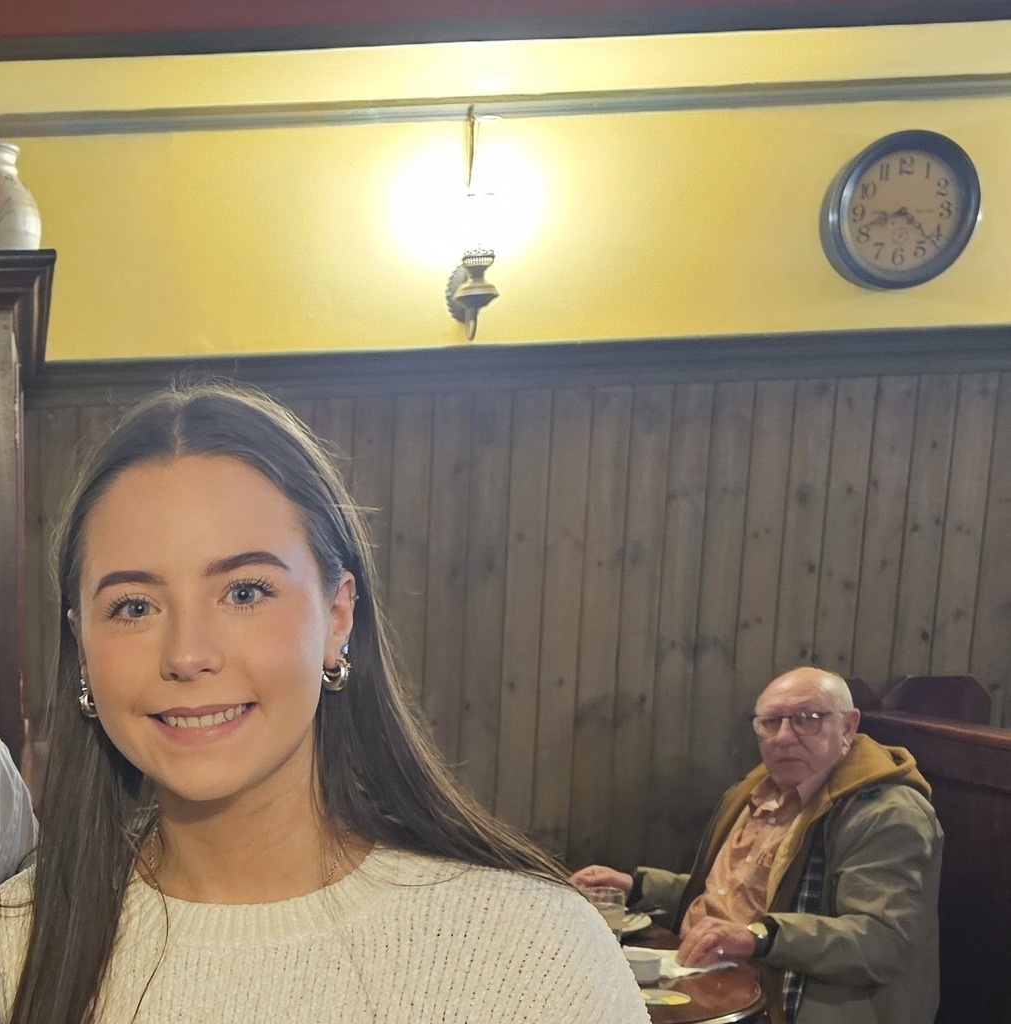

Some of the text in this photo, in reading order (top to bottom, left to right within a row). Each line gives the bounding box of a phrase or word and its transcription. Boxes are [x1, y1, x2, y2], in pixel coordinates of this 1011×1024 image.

[879, 164, 889, 181] 11
[899, 156, 914, 176] 12
[925, 163, 931, 179] 1
[861, 181, 876, 199] 10
[937, 178, 948, 197] 2
[852, 204, 865, 222] 9
[939, 200, 952, 219] 3
[857, 225, 869, 243] 8
[930, 225, 942, 240] 4
[874, 242, 884, 260] 7
[891, 248, 904, 265] 6
[915, 240, 926, 258] 5
